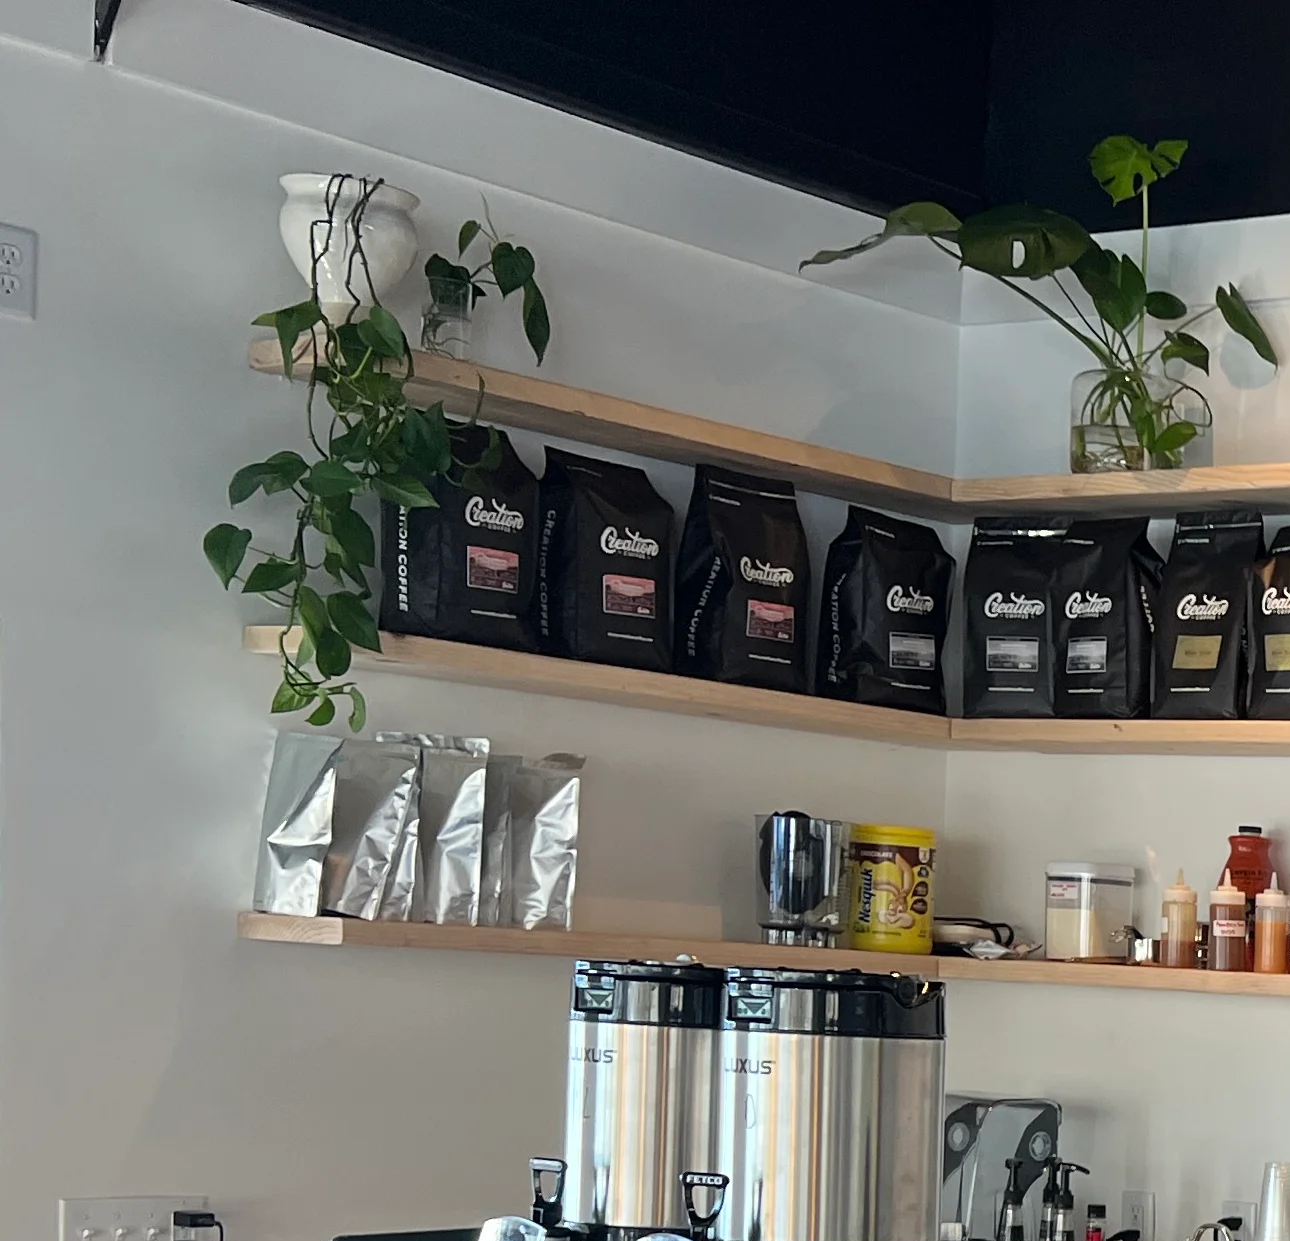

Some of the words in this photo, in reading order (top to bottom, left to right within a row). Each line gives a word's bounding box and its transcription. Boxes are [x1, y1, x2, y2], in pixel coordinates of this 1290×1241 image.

[465, 496, 524, 530] Creation
[601, 526, 659, 556] Creation
[398, 554, 409, 612] COFFEE
[741, 556, 794, 583] Creation
[984, 592, 1045, 618] Creation
[1176, 594, 1229, 619] Creation
[858, 868, 876, 923] Nesquik
[686, 1174, 724, 1185] FETCO
